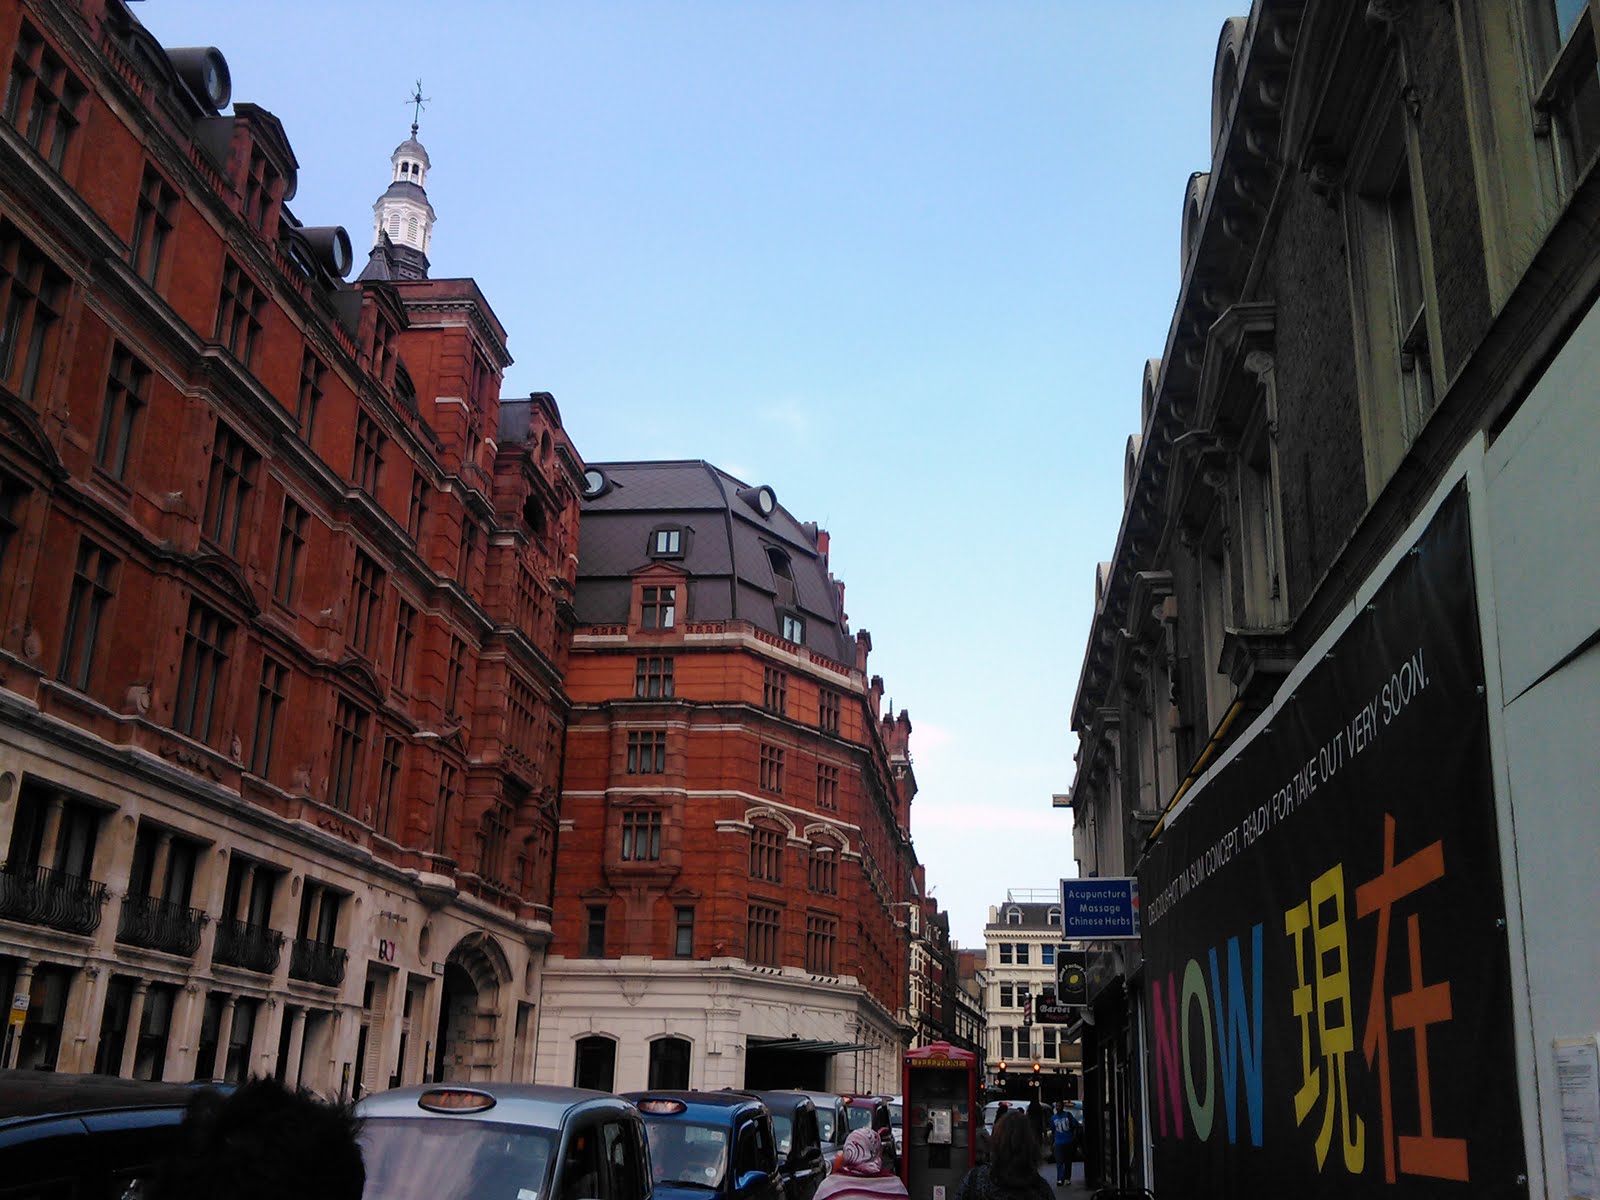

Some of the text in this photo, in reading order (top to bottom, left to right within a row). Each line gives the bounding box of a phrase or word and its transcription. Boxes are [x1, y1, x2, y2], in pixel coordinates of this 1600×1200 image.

[1179, 868, 1190, 898] DIM
[1191, 855, 1205, 889] SUM
[1205, 827, 1240, 878] CONCEPT.
[1243, 800, 1271, 849] READY
[1273, 783, 1294, 825] FOR
[1293, 757, 1317, 807] TAKE
[1319, 731, 1343, 783] OUT
[1346, 695, 1379, 759] VERY
[1382, 647, 1430, 726] SOON.
[1068, 890, 1127, 901] Acupuncture
[1069, 916, 1131, 926] Chinese Herbs
[1079, 904, 1121, 915] Massage
[1152, 922, 1263, 1148] NOW
[1284, 812, 1470, 1184] 現在
